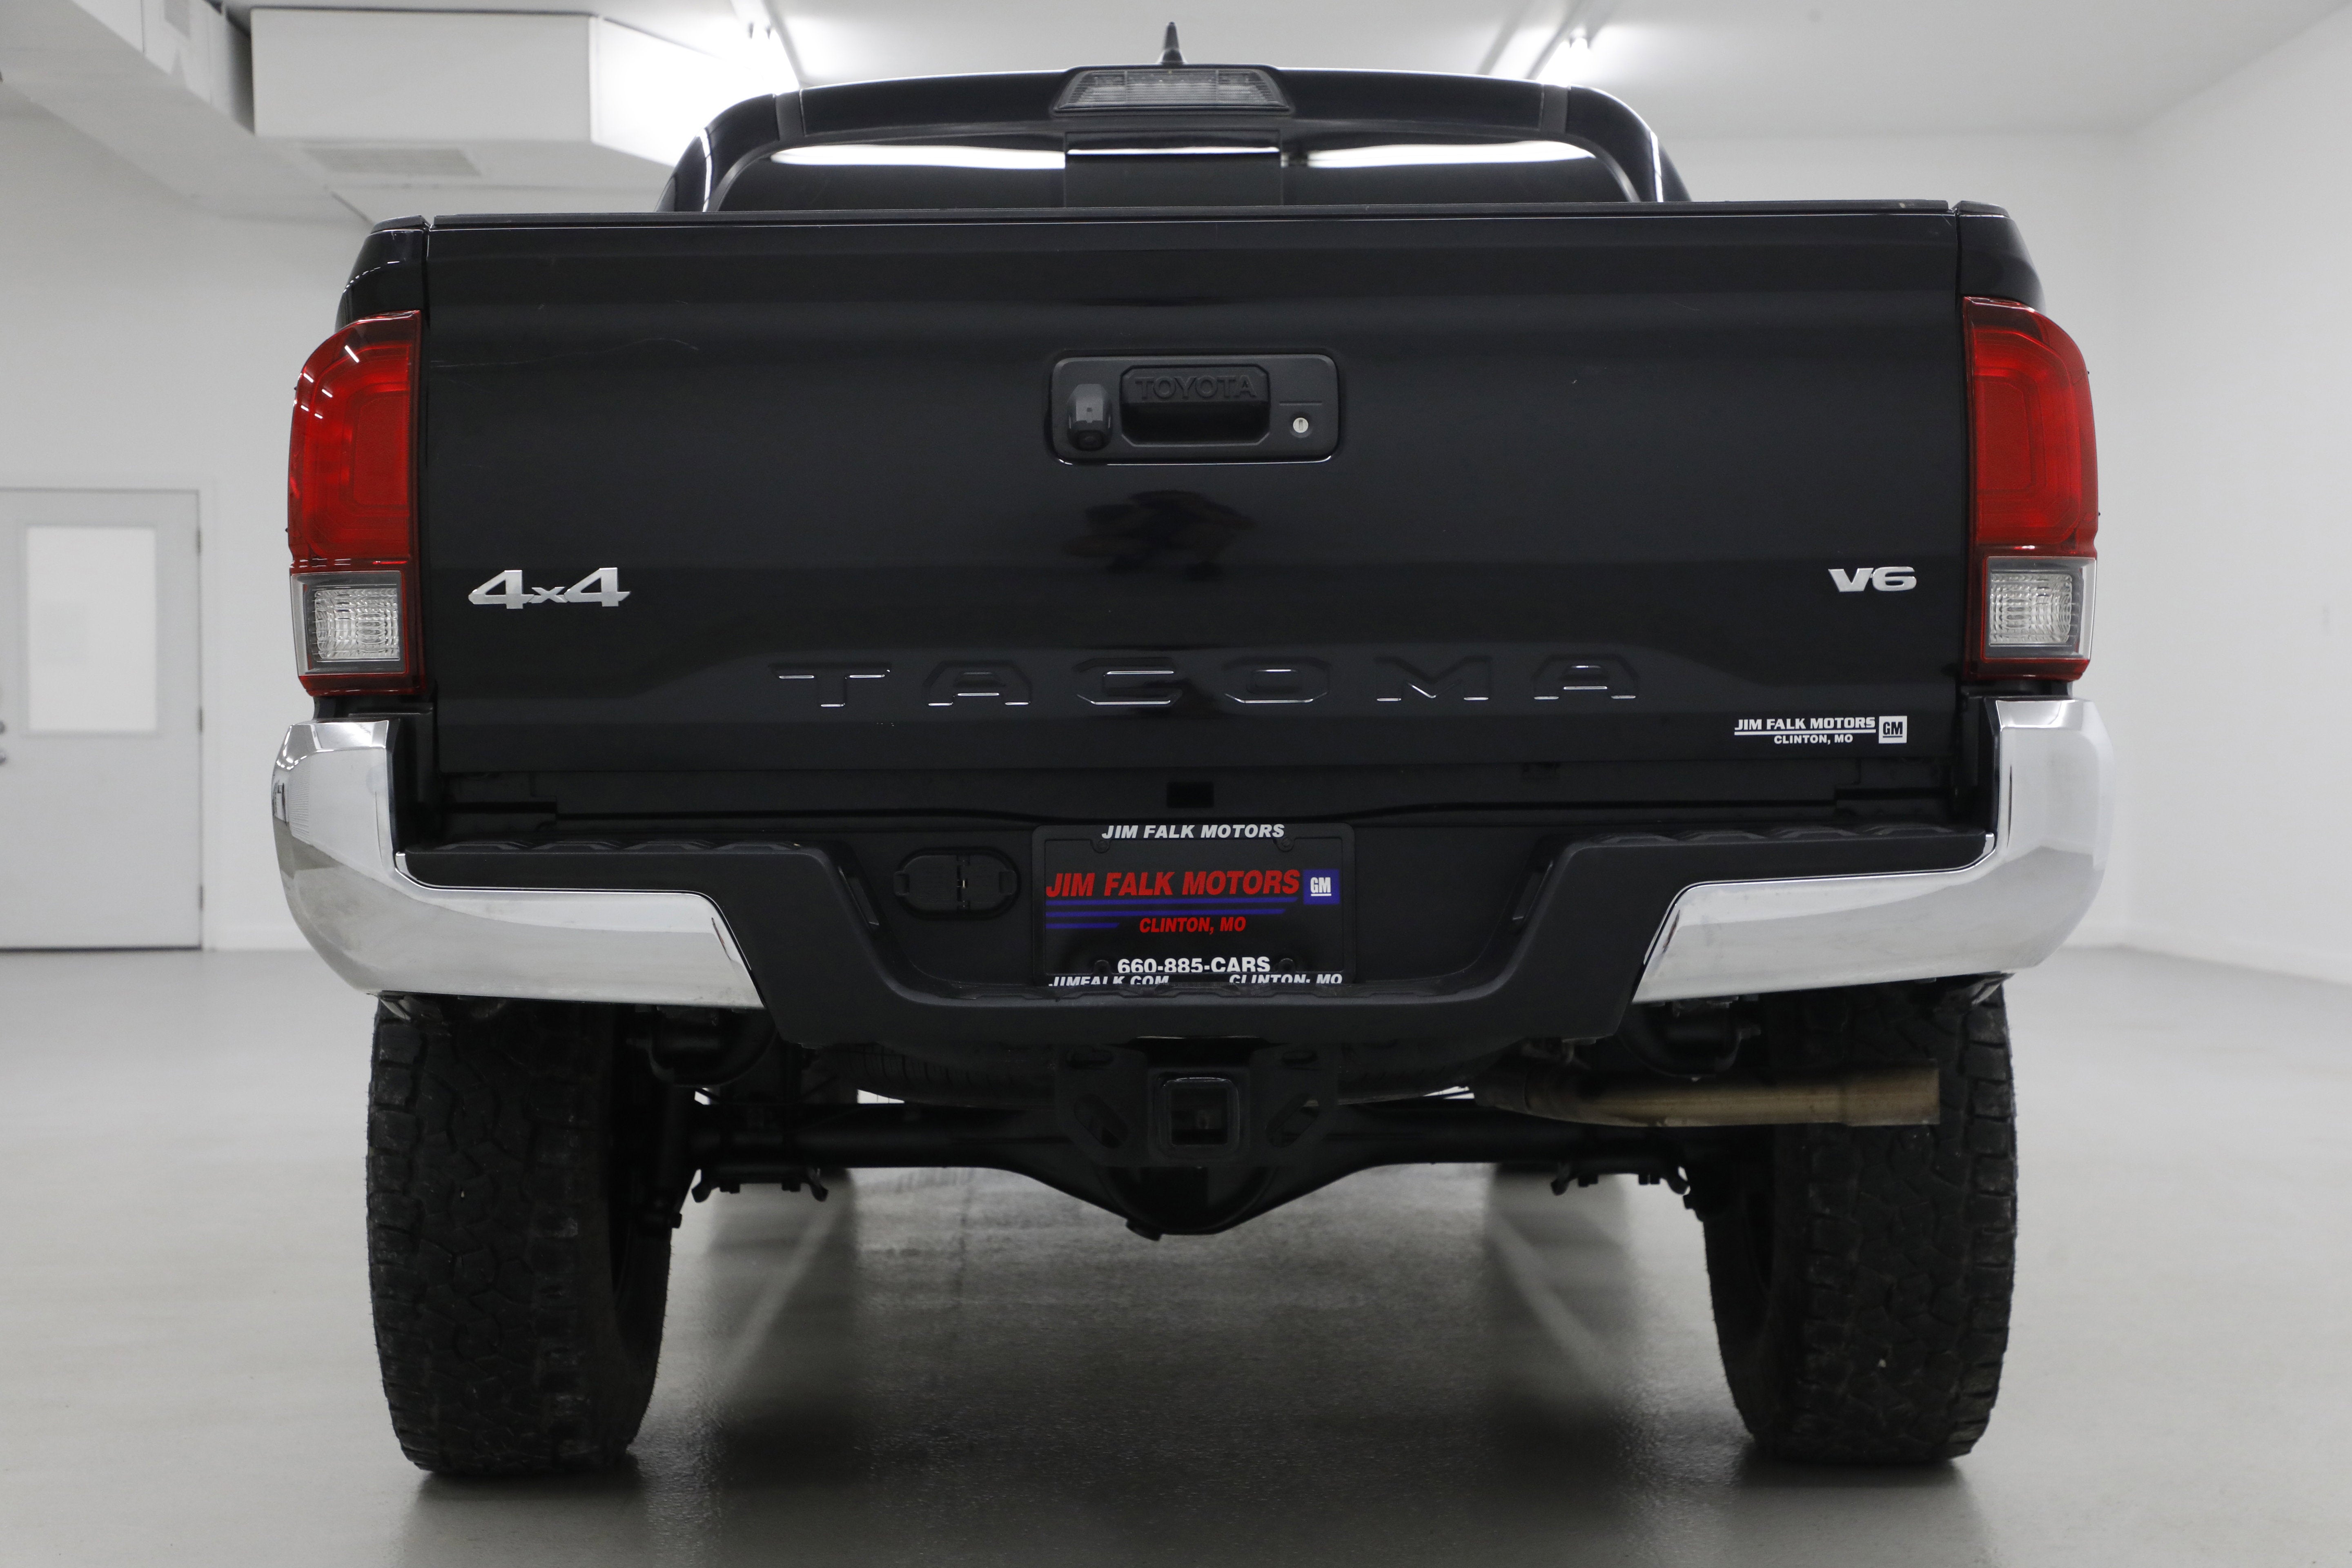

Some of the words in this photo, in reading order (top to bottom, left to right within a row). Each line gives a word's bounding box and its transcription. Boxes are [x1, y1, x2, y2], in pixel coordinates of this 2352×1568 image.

[1135, 375, 1256, 399] TOYOTA
[1828, 566, 1917, 592] V6
[468, 567, 630, 609] 4x4
[768, 654, 1639, 707] TACOMA
[1734, 719, 1762, 730] JIM
[1766, 718, 1806, 730] FALK
[1810, 717, 1875, 729] MOTORS
[1883, 722, 1903, 735] GM
[1774, 735, 1831, 745] CLINTON,
[1834, 734, 1853, 743] MO
[1101, 825, 1138, 839] JIM
[1143, 825, 1195, 838] FALK
[1200, 824, 1285, 838] MOTORS
[1046, 873, 1095, 897] JIM
[1104, 872, 1175, 896] FALK
[1182, 870, 1300, 895] MOTORS
[1310, 877, 1331, 893] GM
[1139, 918, 1214, 934] CLINTON,
[1220, 917, 1247, 932] MO
[1118, 956, 1270, 973] 660-885-CARS
[1049, 976, 1169, 986] JIMFALKCOM
[1316, 973, 1343, 984] MO
